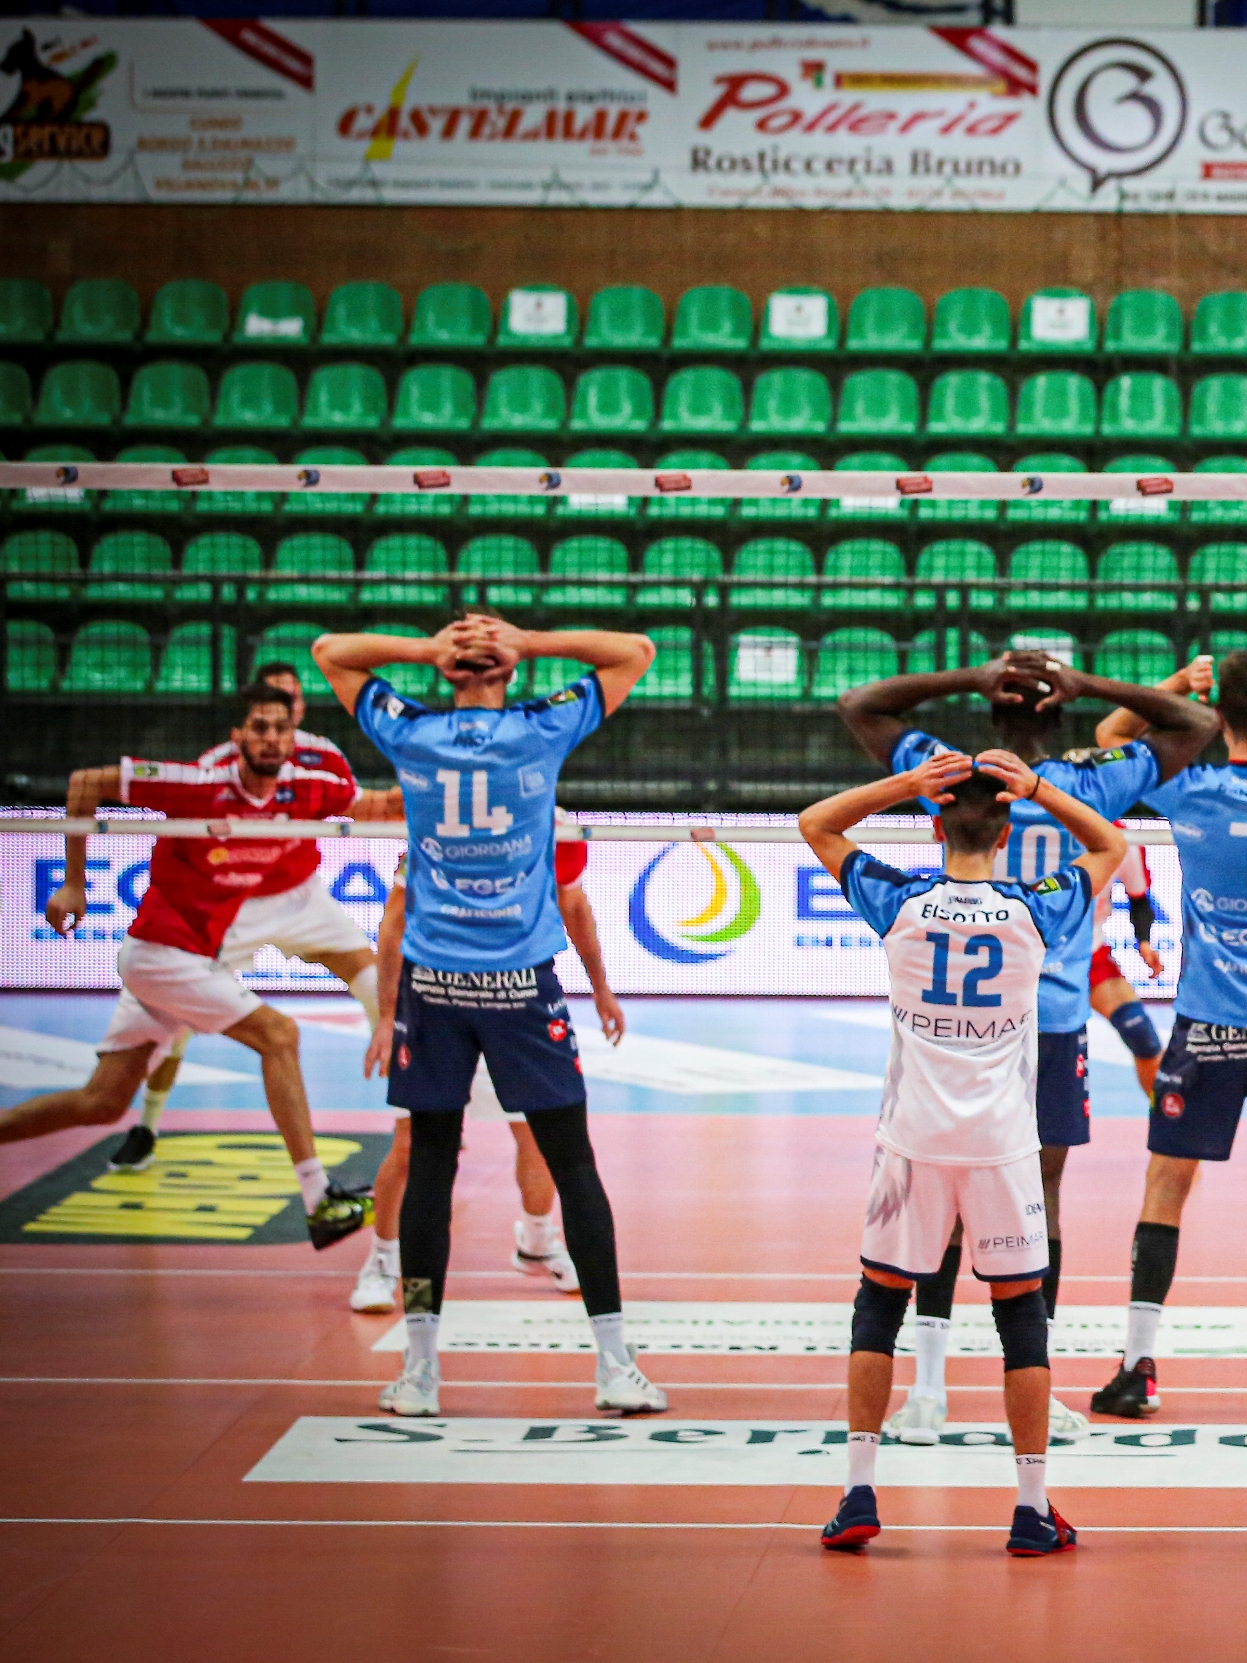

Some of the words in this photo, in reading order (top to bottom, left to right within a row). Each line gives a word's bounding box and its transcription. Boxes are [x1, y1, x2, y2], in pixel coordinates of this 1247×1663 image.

[697, 71, 1024, 137] Polleria
[688, 144, 895, 178] Rosticceria
[908, 145, 1023, 179] Bruno
[436, 769, 514, 837] 14
[438, 967, 538, 990] GENERALI
[921, 931, 1004, 1007] 12
